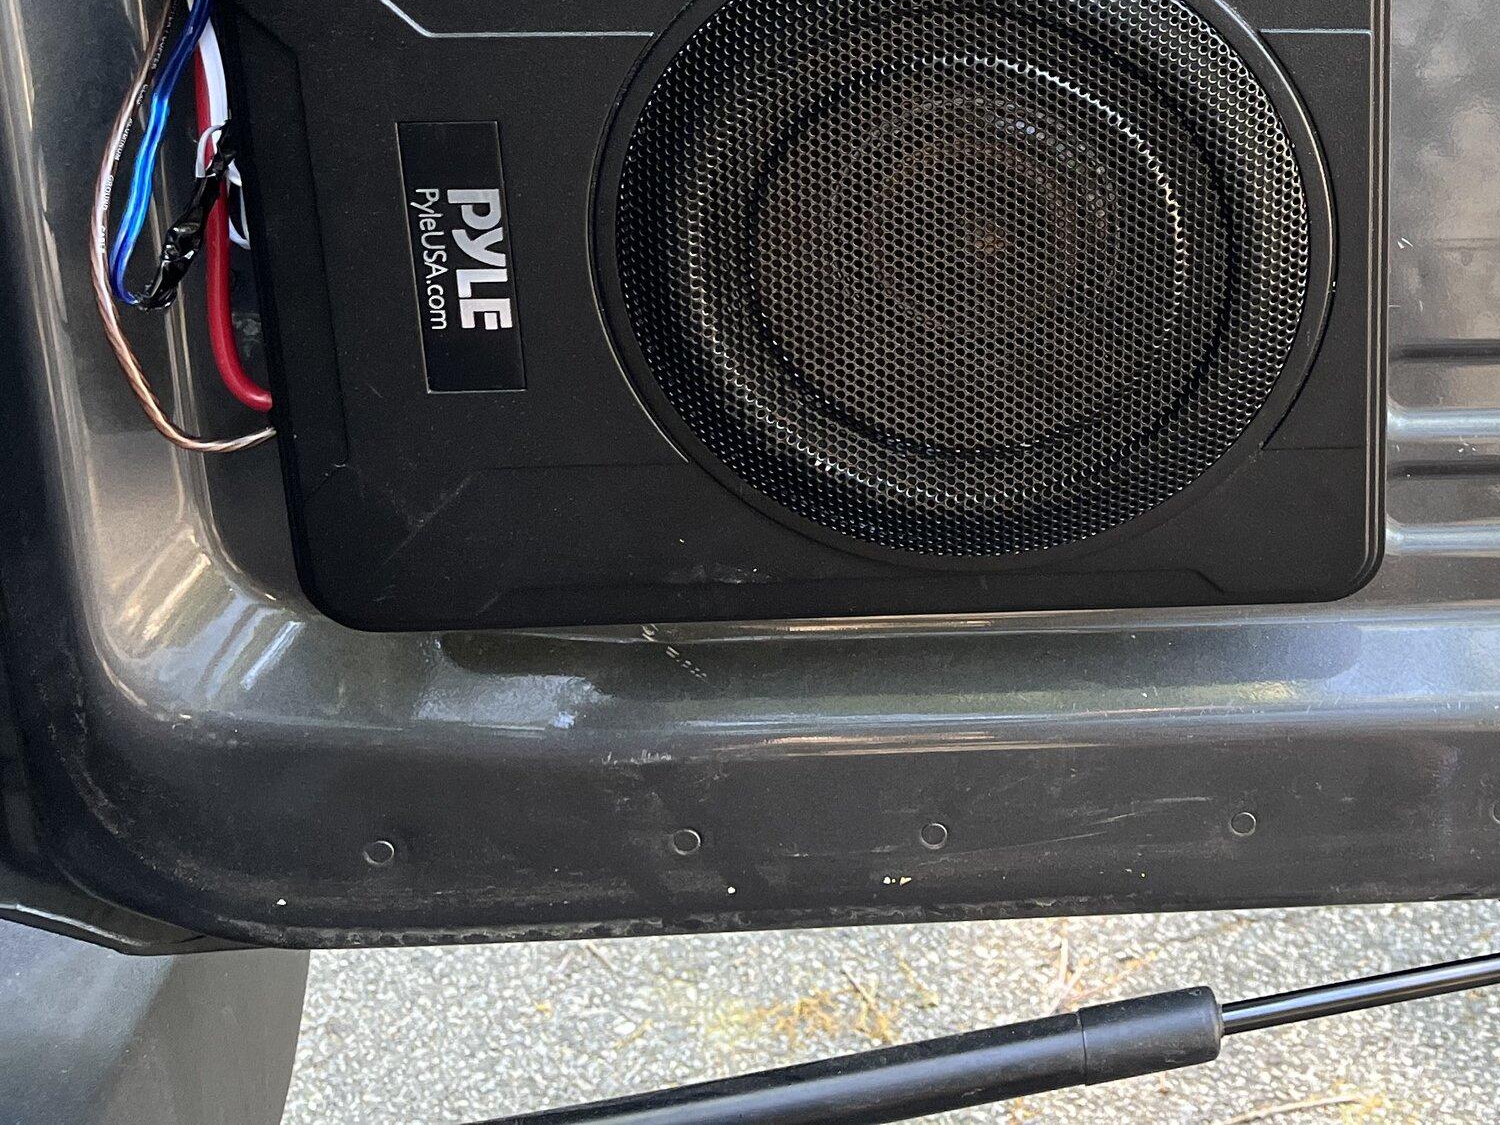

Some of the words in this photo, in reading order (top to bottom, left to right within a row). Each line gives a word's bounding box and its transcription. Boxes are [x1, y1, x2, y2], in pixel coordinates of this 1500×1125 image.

[114, 117, 133, 162] ALUMINUM
[101, 174, 114, 211] GROUND
[410, 188, 449, 330] PyleUSA.com
[447, 188, 513, 331] PYLE
